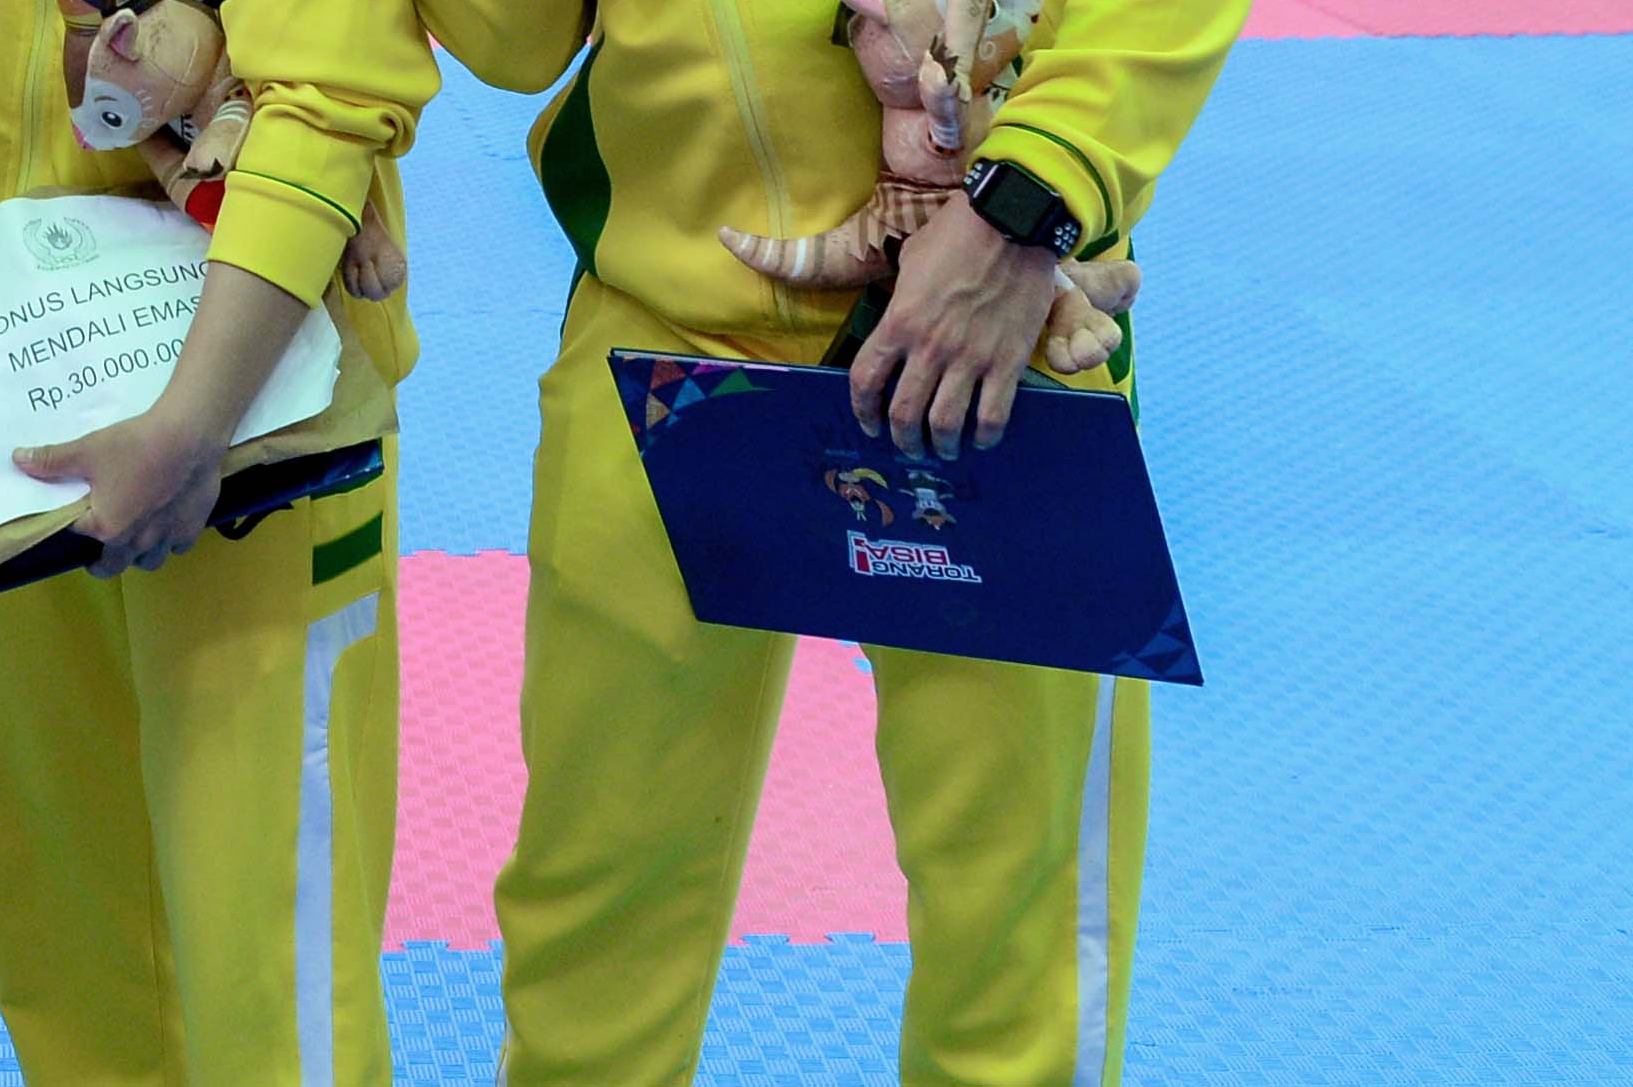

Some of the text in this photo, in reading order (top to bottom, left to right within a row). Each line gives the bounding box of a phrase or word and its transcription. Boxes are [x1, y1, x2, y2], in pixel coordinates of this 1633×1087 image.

[8, 295, 201, 373] MENDALI EMAS
[27, 338, 185, 412] Rp.30.000.00
